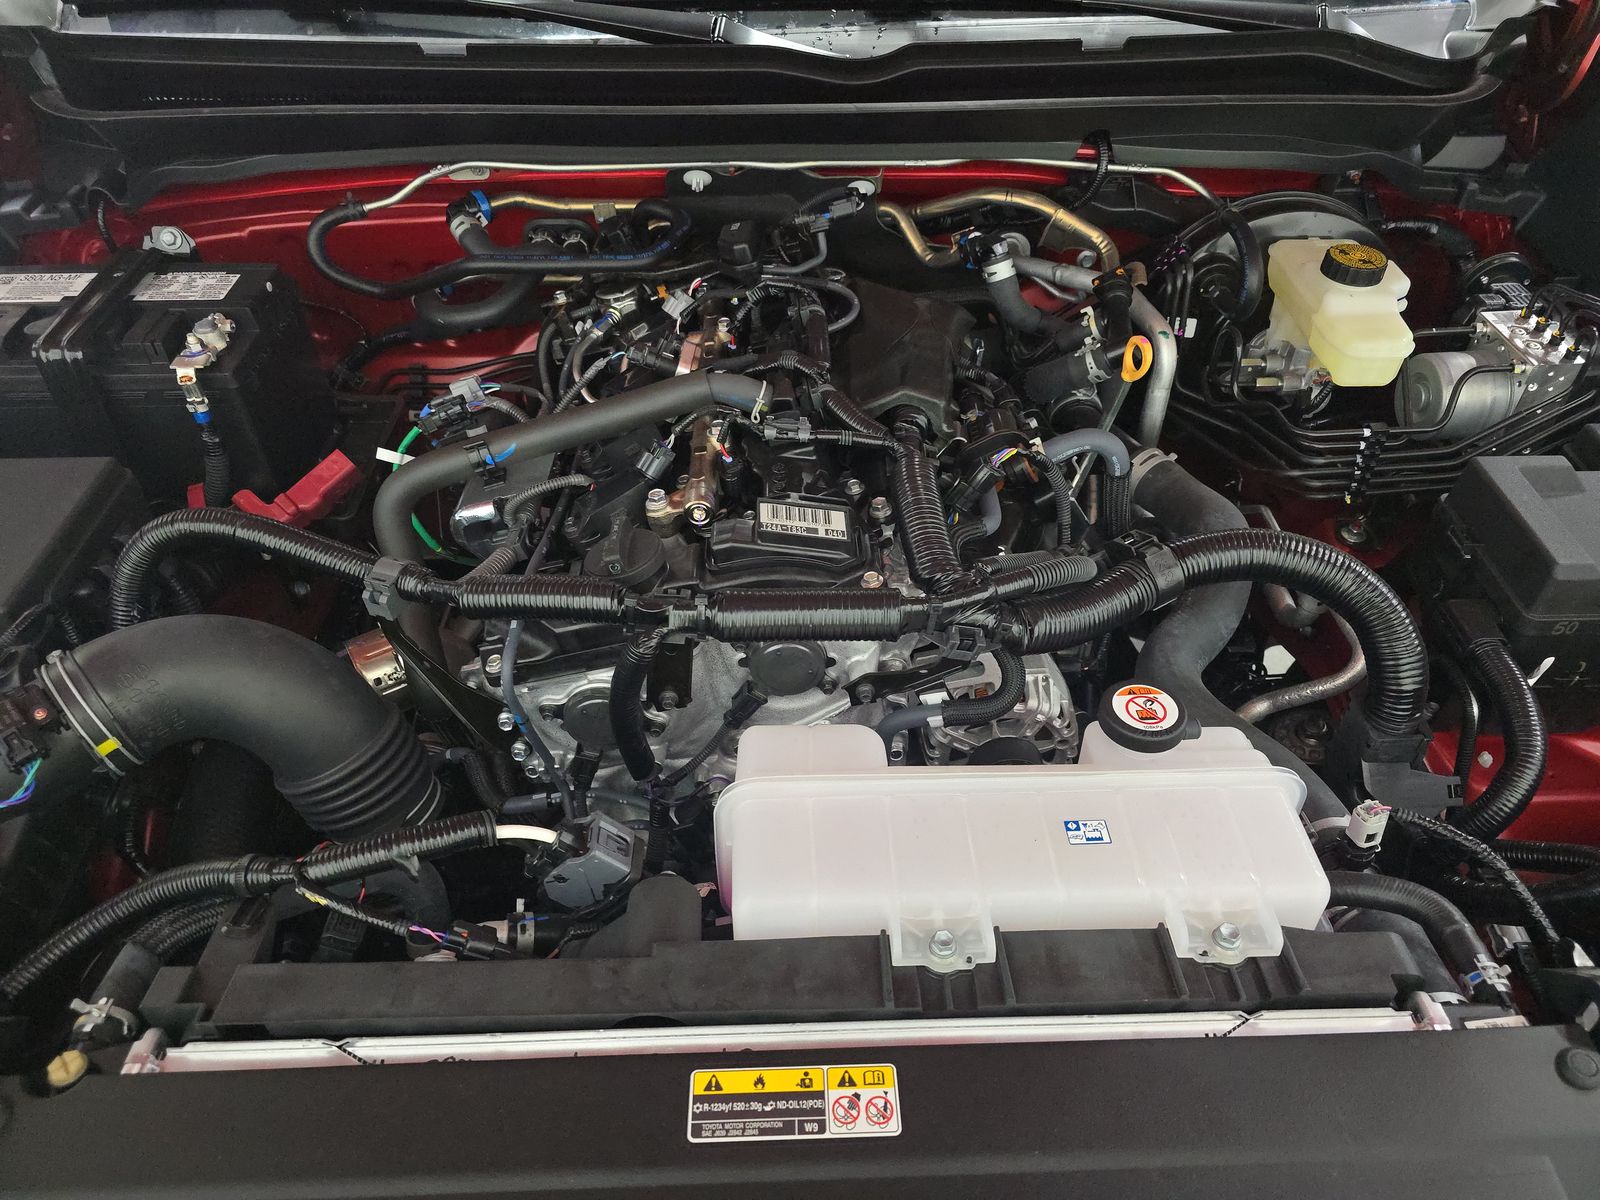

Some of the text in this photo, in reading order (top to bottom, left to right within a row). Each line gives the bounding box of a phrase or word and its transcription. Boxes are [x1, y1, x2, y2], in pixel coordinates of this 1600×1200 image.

[703, 1101, 732, 1113] R-1234yf
[776, 1099, 825, 1109] ND-OIL12(POE)
[702, 1121, 783, 1131] TOYOTA MOTOR CORPORATION
[804, 1122, 819, 1132] W9
